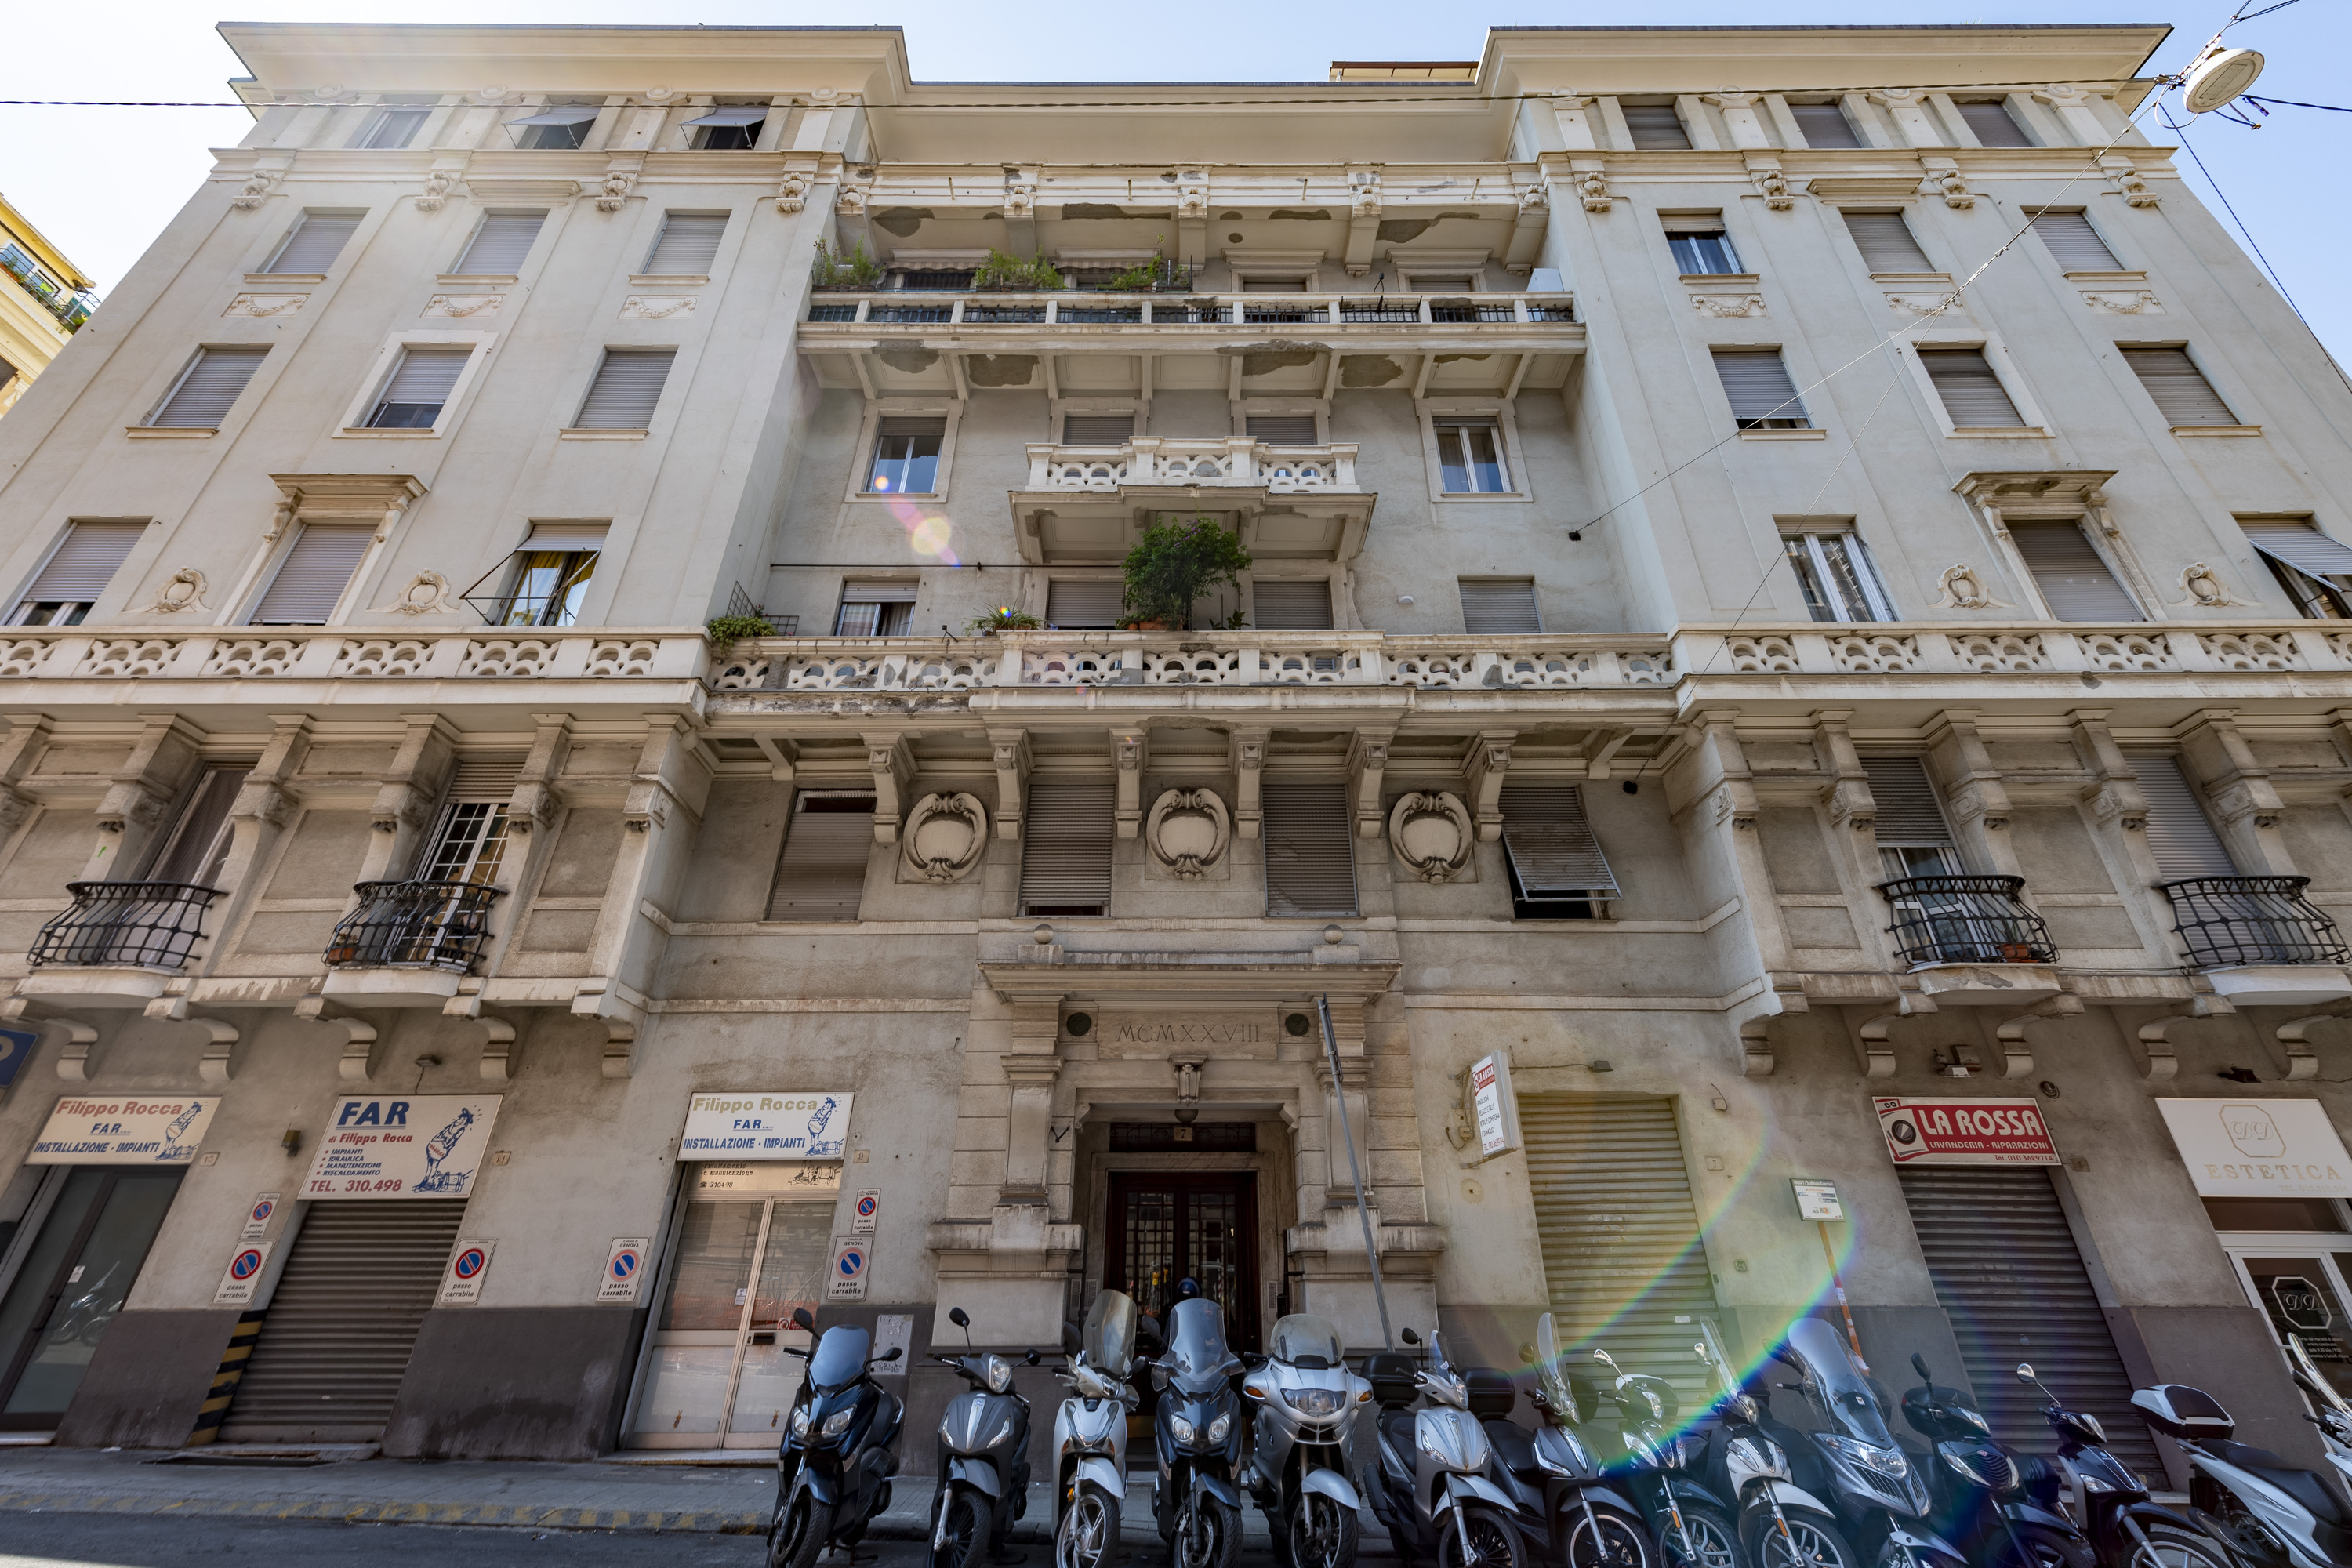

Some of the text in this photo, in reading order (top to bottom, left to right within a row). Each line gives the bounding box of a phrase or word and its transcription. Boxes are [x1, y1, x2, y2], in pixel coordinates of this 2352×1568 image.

[1116, 1025, 1259, 1043] MCMXXVIII
[56, 1100, 183, 1118] Filippo Rocca
[693, 1098, 818, 1114] Filippo Rocca
[336, 1101, 410, 1126] FAR
[1918, 1109, 2044, 1136] LA ROSSA
[328, 1132, 413, 1145] di Filippo Rocca
[1180, 1129, 1186, 1138] 7
[34, 1142, 161, 1153] INSTALLAZIONE IMPIANTI
[683, 1138, 806, 1149] INSTALLAZIONE IMPIANTI
[1929, 1141, 1984, 1149] LAVANDERIA
[496, 1154, 506, 1163] 11
[2203, 1164, 2343, 1181] ESTETICA
[310, 1179, 403, 1192] TEL. 310.498
